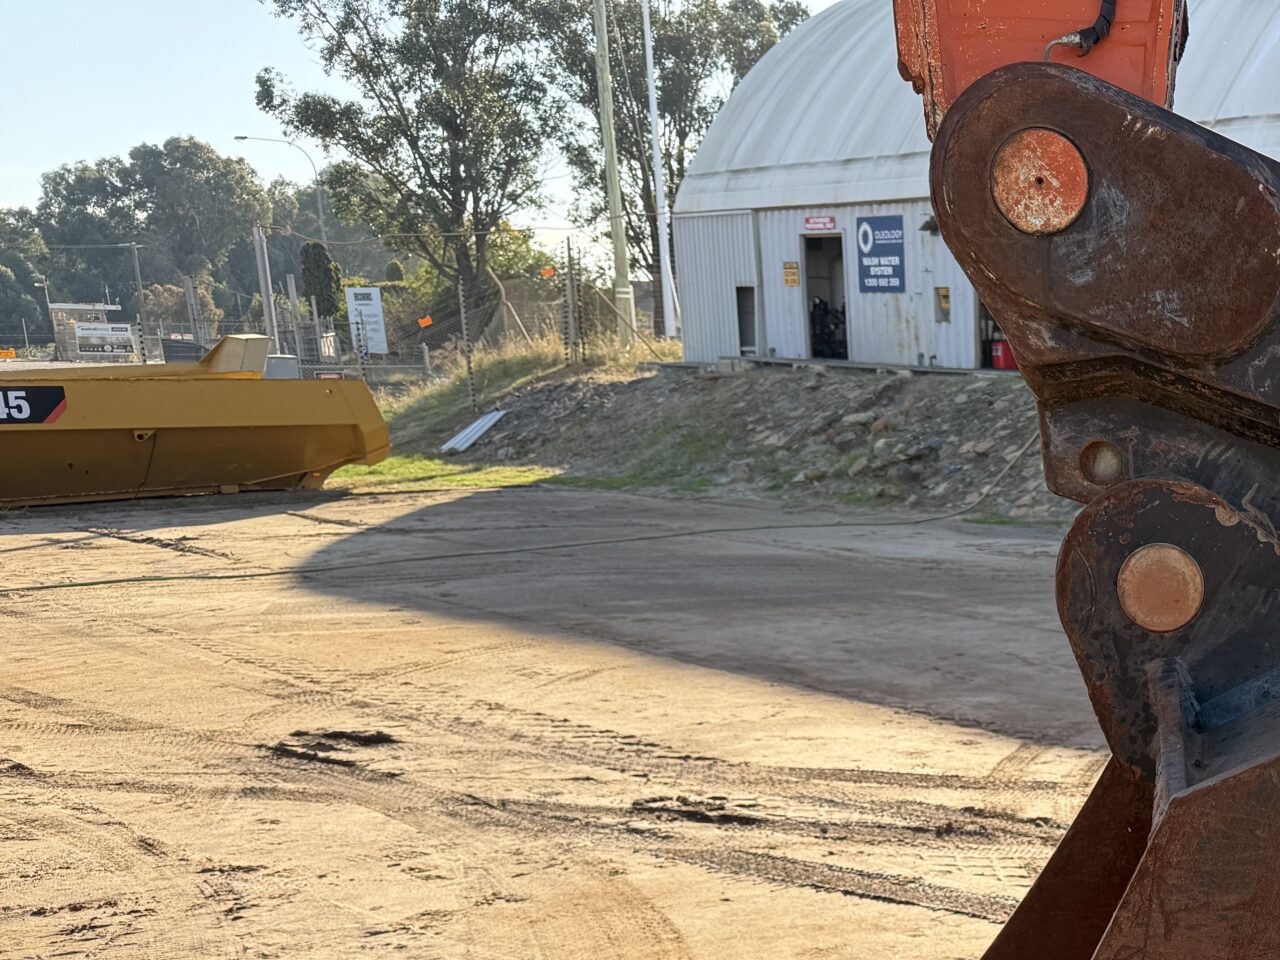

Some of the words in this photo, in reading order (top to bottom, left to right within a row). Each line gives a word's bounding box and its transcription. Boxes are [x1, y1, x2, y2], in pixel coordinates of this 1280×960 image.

[862, 257, 879, 266] WASH
[880, 256, 900, 265] WATER
[869, 266, 894, 275] SYSTEM
